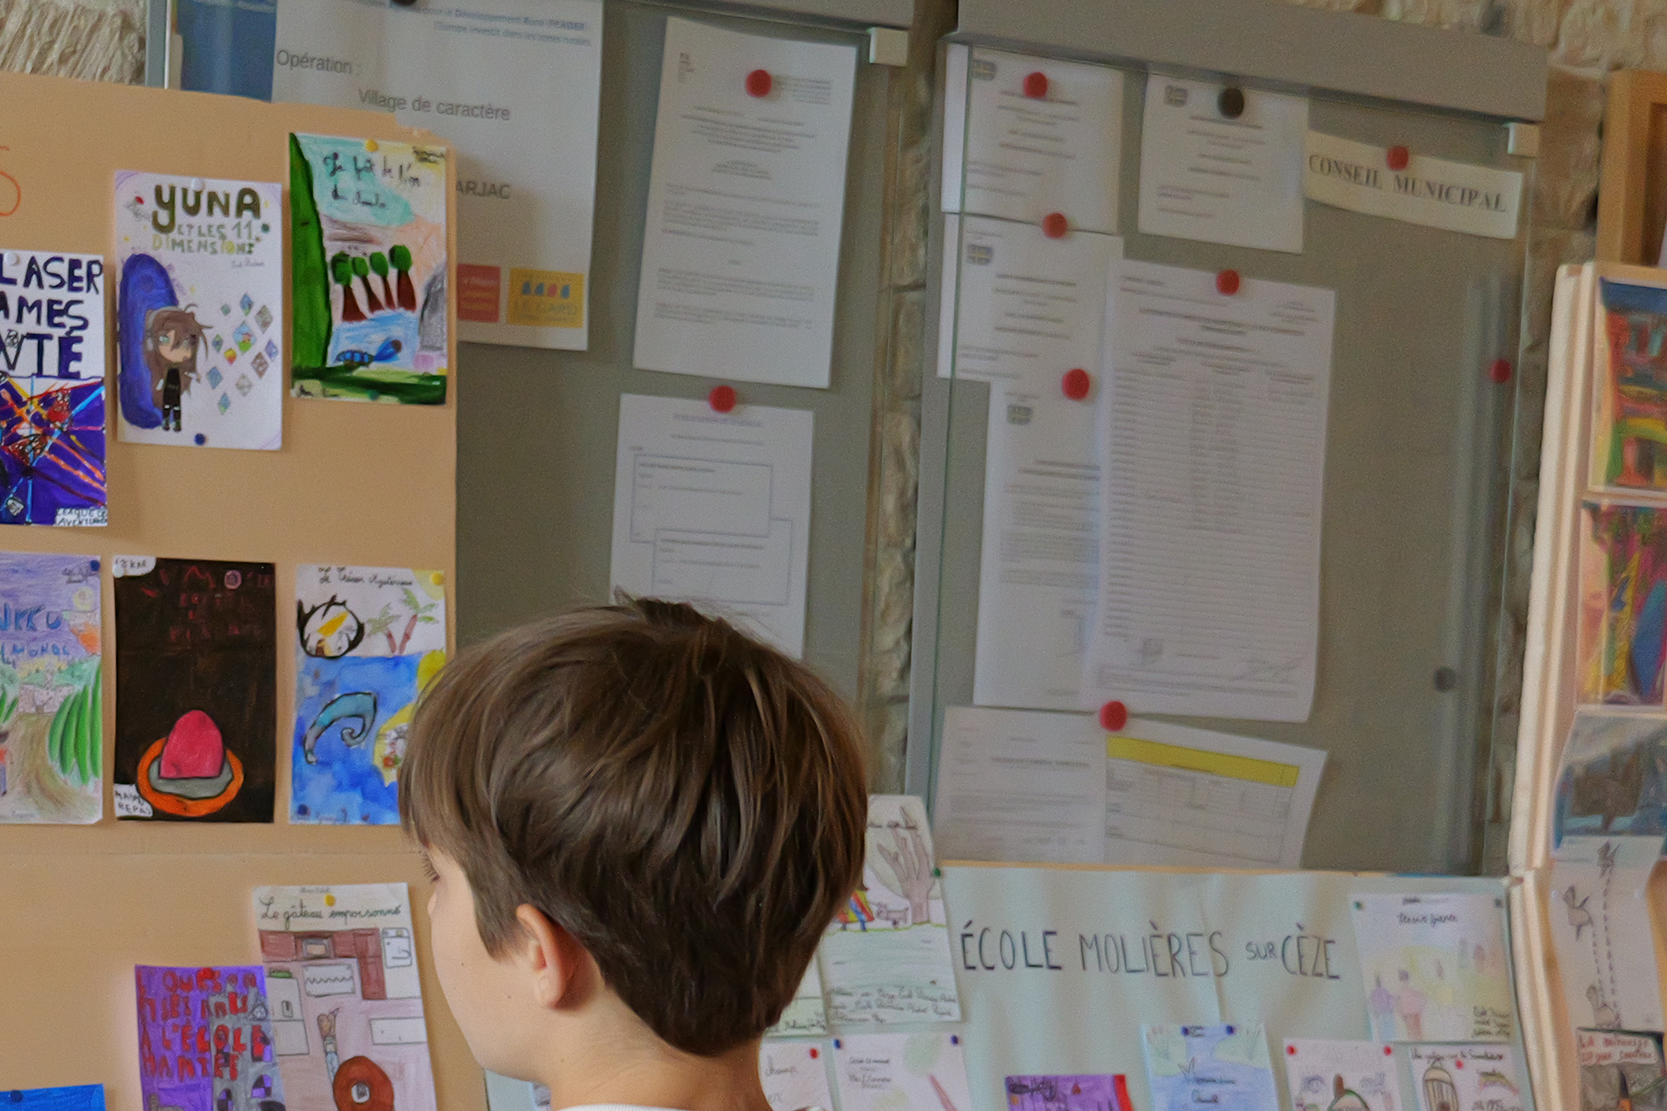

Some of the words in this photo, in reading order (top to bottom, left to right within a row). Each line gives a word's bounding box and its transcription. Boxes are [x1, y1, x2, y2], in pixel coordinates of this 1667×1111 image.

[276, 48, 354, 76] Opération
[357, 88, 407, 114] Village
[411, 96, 432, 113] de
[436, 101, 511, 122] caractère
[1308, 153, 1383, 190] CONSEIL
[1392, 173, 1507, 213] MUNICIPAL
[960, 919, 1064, 973] ÉCOLE
[1078, 919, 1230, 978] MOLIÈRES
[1245, 940, 1279, 963] SUR
[1280, 922, 1341, 981] CÈZE
